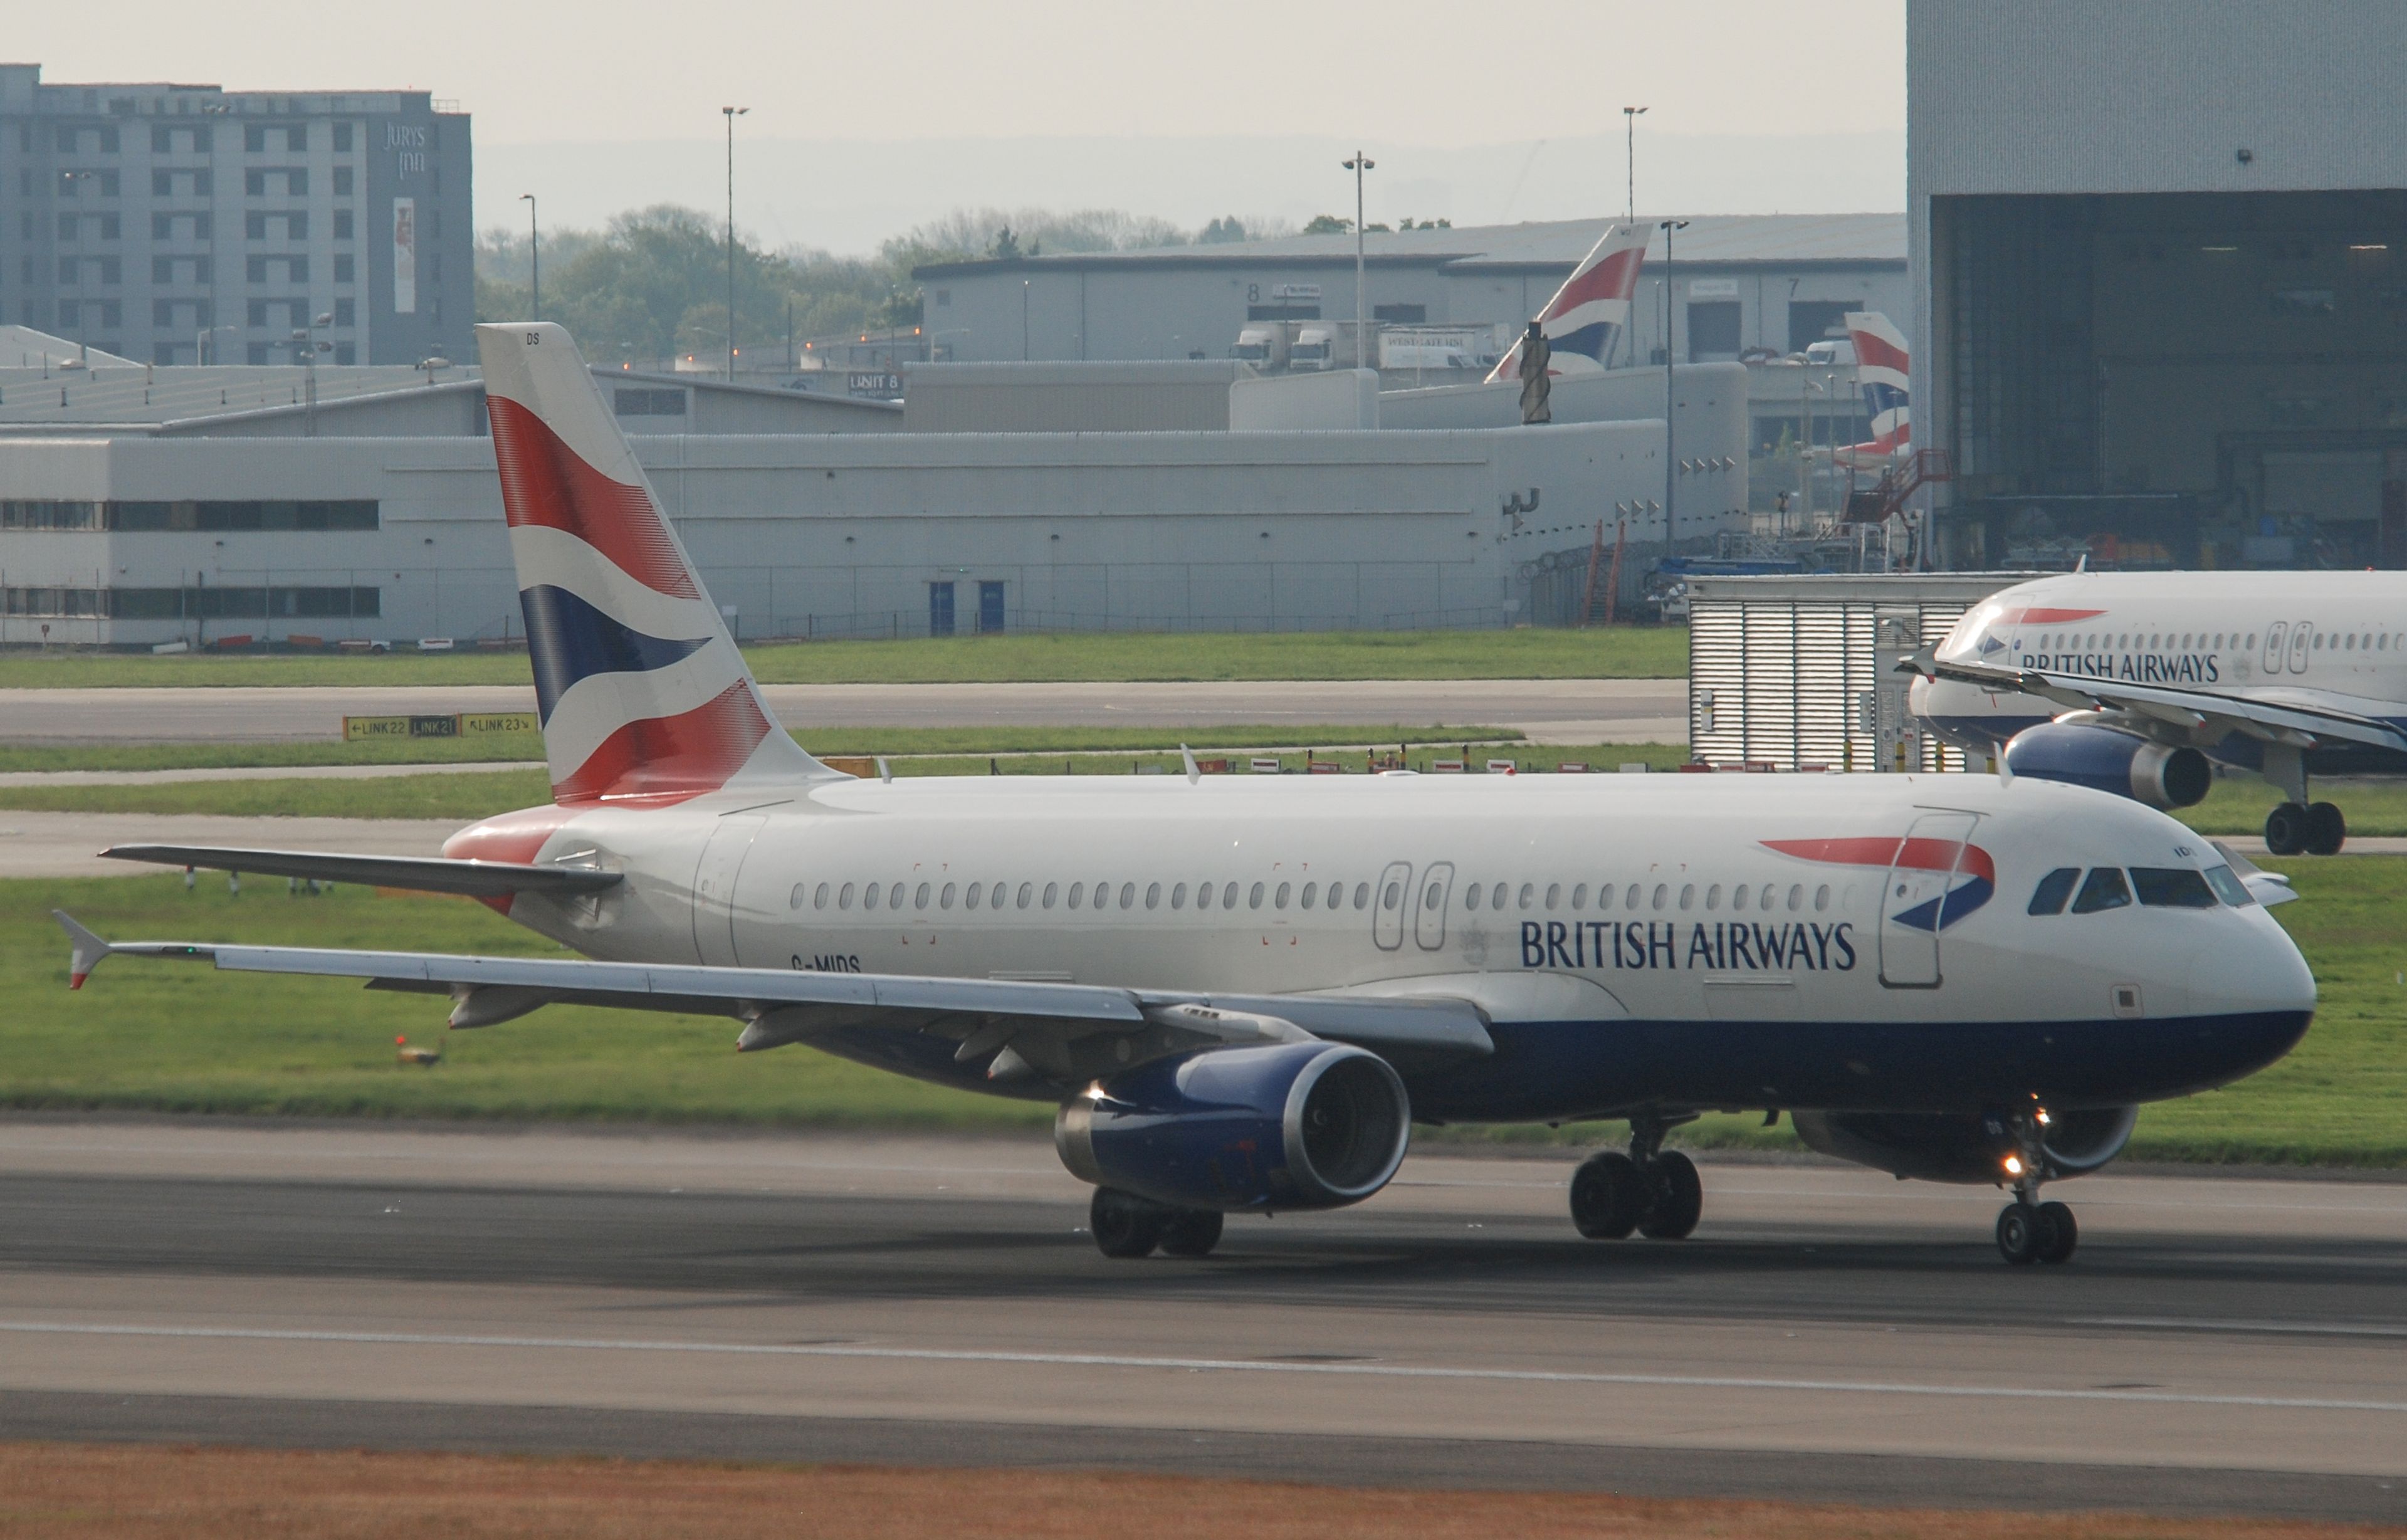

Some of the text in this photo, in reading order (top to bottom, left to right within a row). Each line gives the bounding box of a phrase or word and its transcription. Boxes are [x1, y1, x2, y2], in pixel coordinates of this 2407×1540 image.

[383, 121, 425, 150] JURYS
[1248, 284, 1259, 302] 8
[1788, 278, 1799, 297] 7
[527, 332, 540, 345] DS
[850, 374, 898, 389] UNIT 8
[2122, 654, 2219, 683] AIRWAYS
[1521, 921, 1857, 972] BRITISH AIRWAYS
